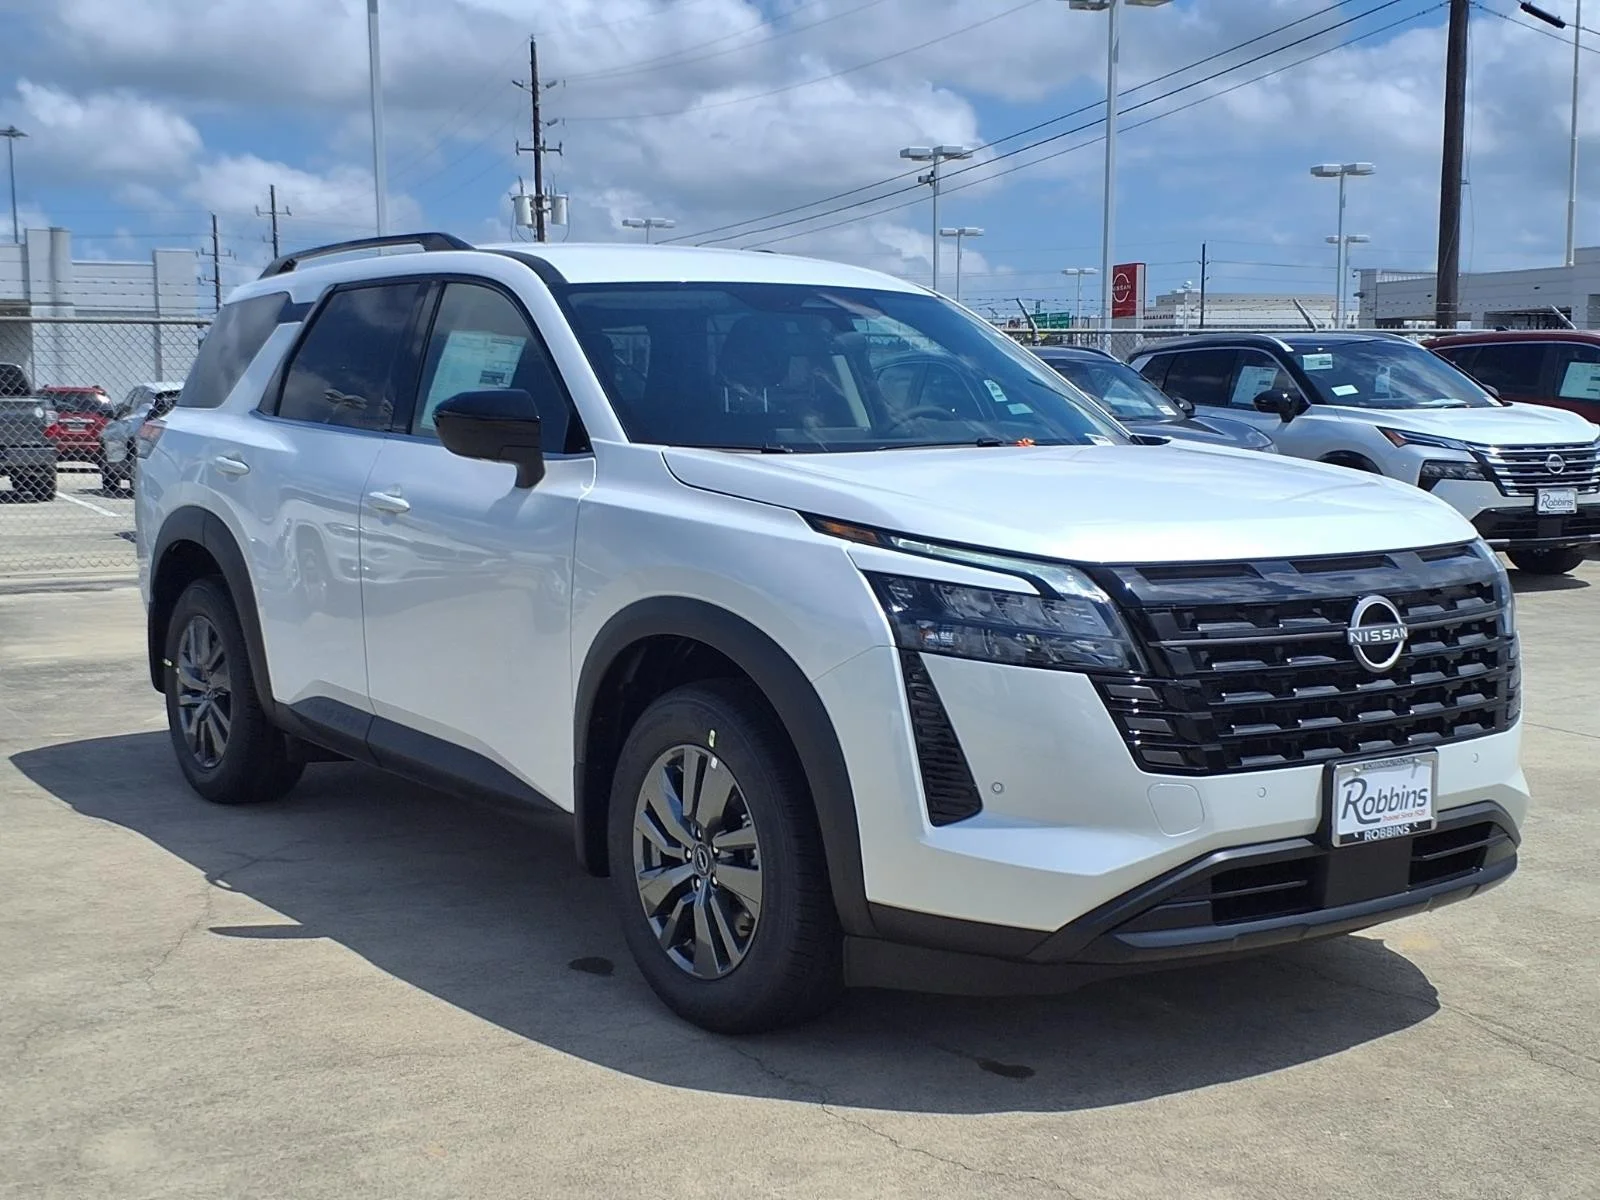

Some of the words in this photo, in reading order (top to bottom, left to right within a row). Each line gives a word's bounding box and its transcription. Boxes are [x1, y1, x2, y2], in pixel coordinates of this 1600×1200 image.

[1540, 493, 1574, 509] Robbins
[1349, 626, 1408, 643] NISSAN
[1341, 777, 1428, 825] Robbins
[1364, 823, 1410, 841] ROBBINS
